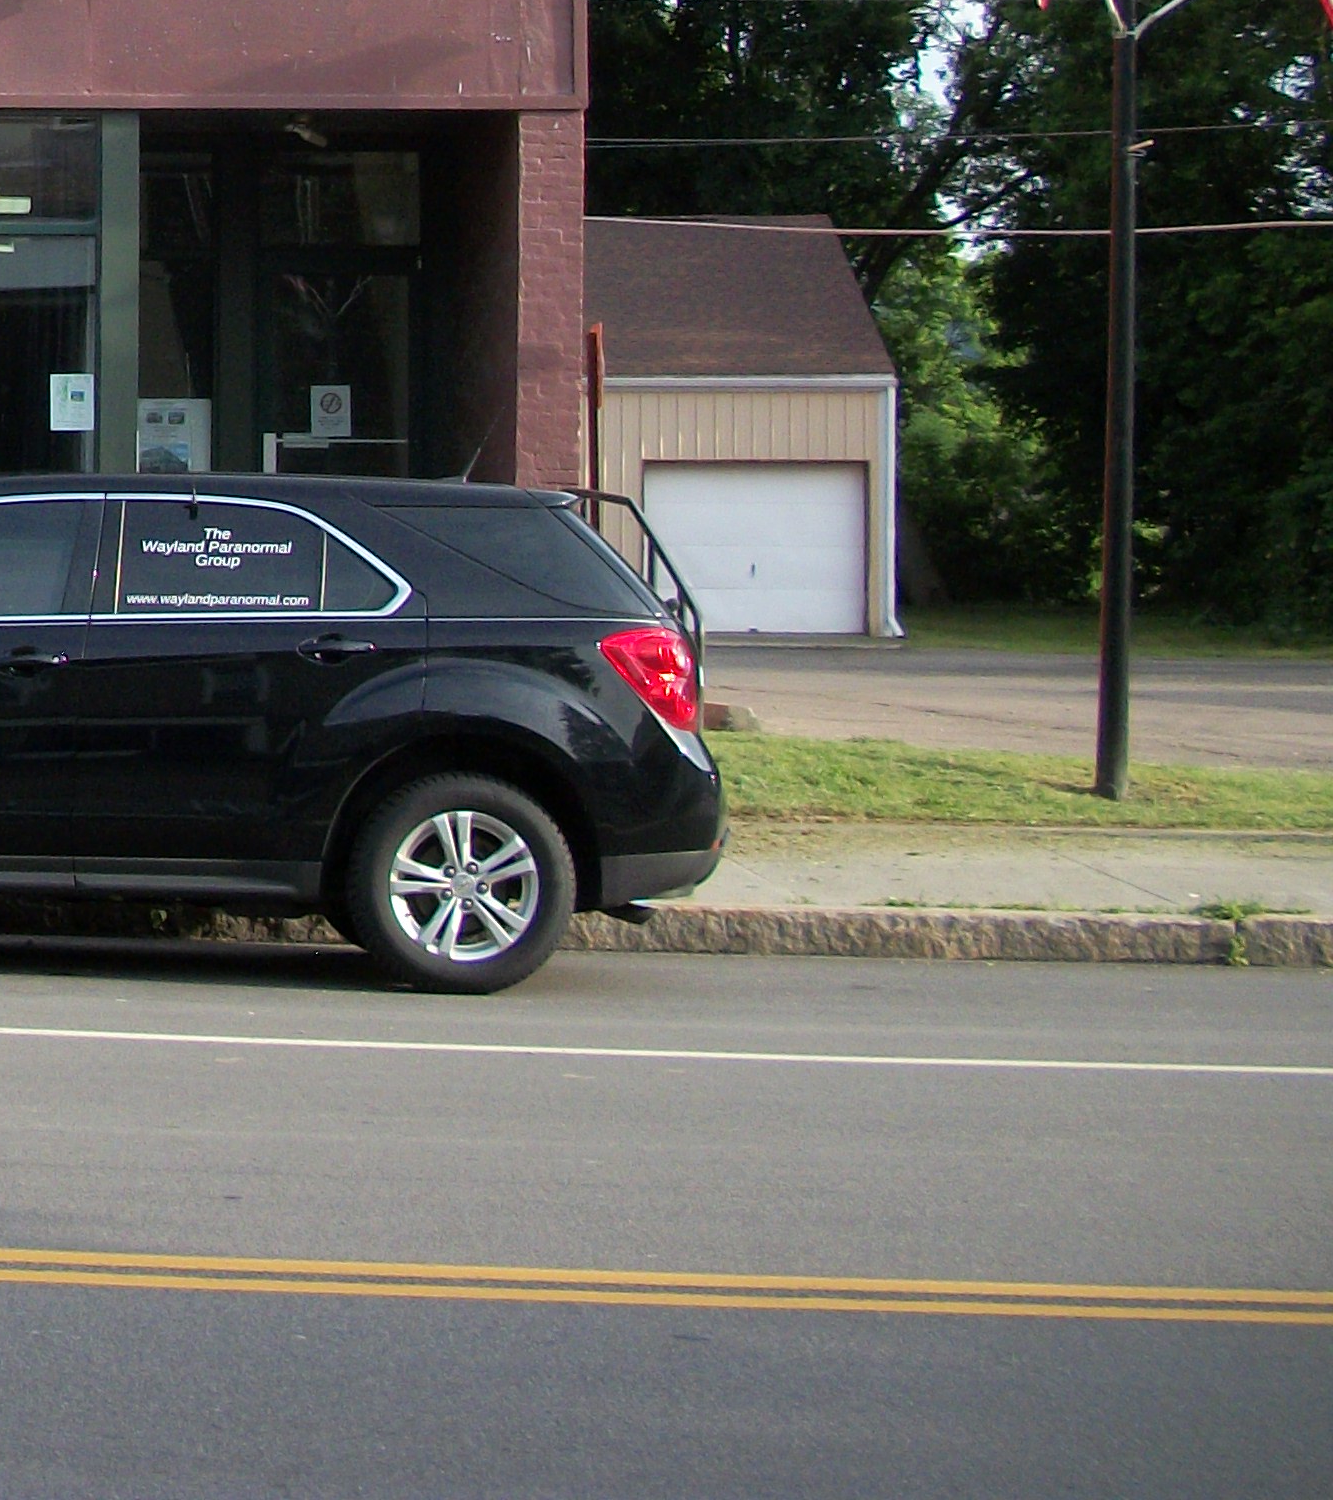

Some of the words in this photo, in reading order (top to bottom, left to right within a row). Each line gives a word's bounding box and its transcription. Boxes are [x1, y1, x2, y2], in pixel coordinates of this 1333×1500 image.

[204, 527, 232, 541] The
[142, 540, 206, 556] Wayland
[208, 541, 293, 555] Paranormal
[195, 554, 241, 570] Group
[126, 593, 310, 608] www.waylandparanormal.com
